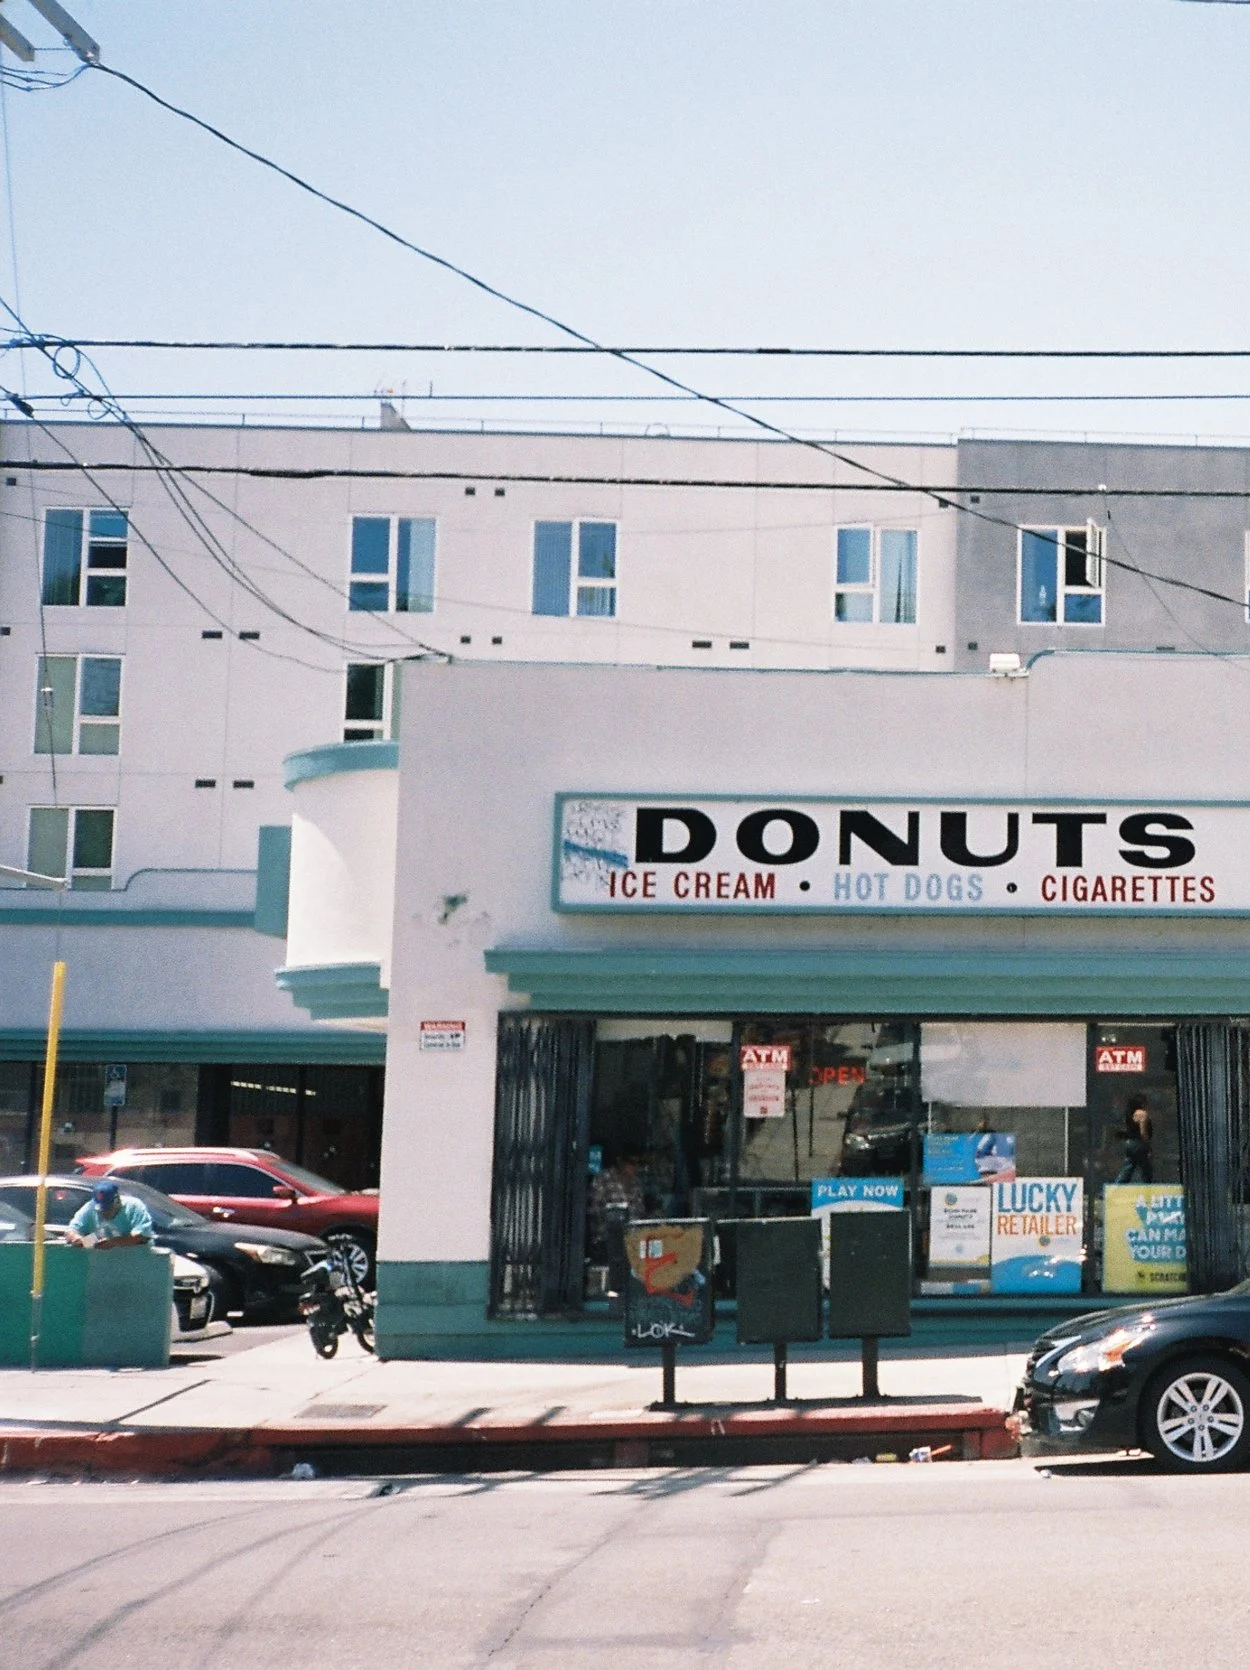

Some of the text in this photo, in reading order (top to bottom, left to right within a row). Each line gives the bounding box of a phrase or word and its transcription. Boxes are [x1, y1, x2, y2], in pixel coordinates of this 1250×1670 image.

[634, 807, 1197, 869] DONUTS
[609, 871, 1217, 903] ICE CREAM HOT DOGS CIGARETTES
[743, 1049, 788, 1063] ATM
[1099, 1050, 1143, 1064] ATM
[808, 1066, 865, 1085] OPEN
[817, 1185, 898, 1198] PLAY NOW
[997, 1183, 1077, 1213] LUCKY
[997, 1215, 1077, 1236] RETAILER
[1126, 1228, 1161, 1242] CAN
[1131, 1245, 1172, 1260] YOUR
